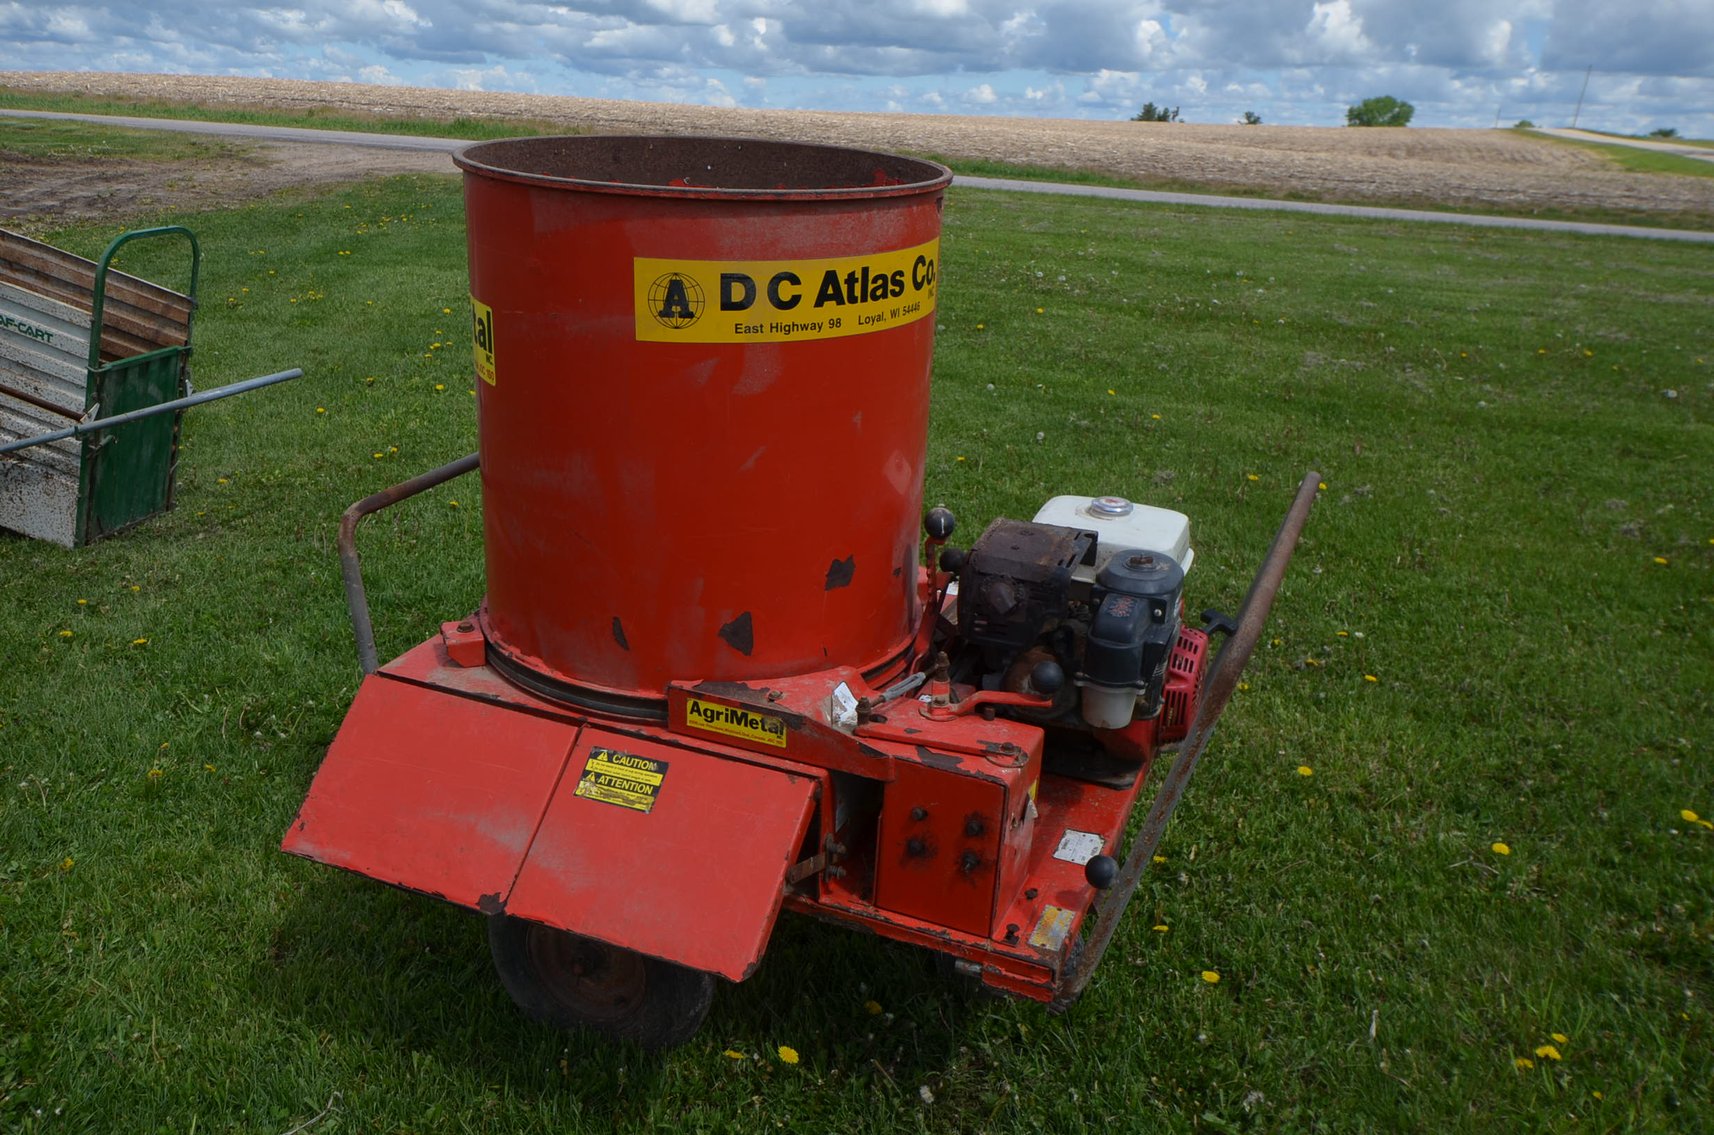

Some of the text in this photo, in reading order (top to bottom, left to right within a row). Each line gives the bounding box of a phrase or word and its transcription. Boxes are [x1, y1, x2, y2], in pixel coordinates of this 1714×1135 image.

[720, 254, 936, 311] D C Atlas Co.
[734, 322, 764, 334] East
[769, 321, 824, 335] Highway
[828, 318, 842, 329] 98
[858, 311, 887, 326] Loyal,
[890, 307, 900, 319] WI
[689, 700, 785, 736] AgriMetal
[612, 754, 658, 771] CAUTION
[597, 774, 653, 795] ATTENTION
